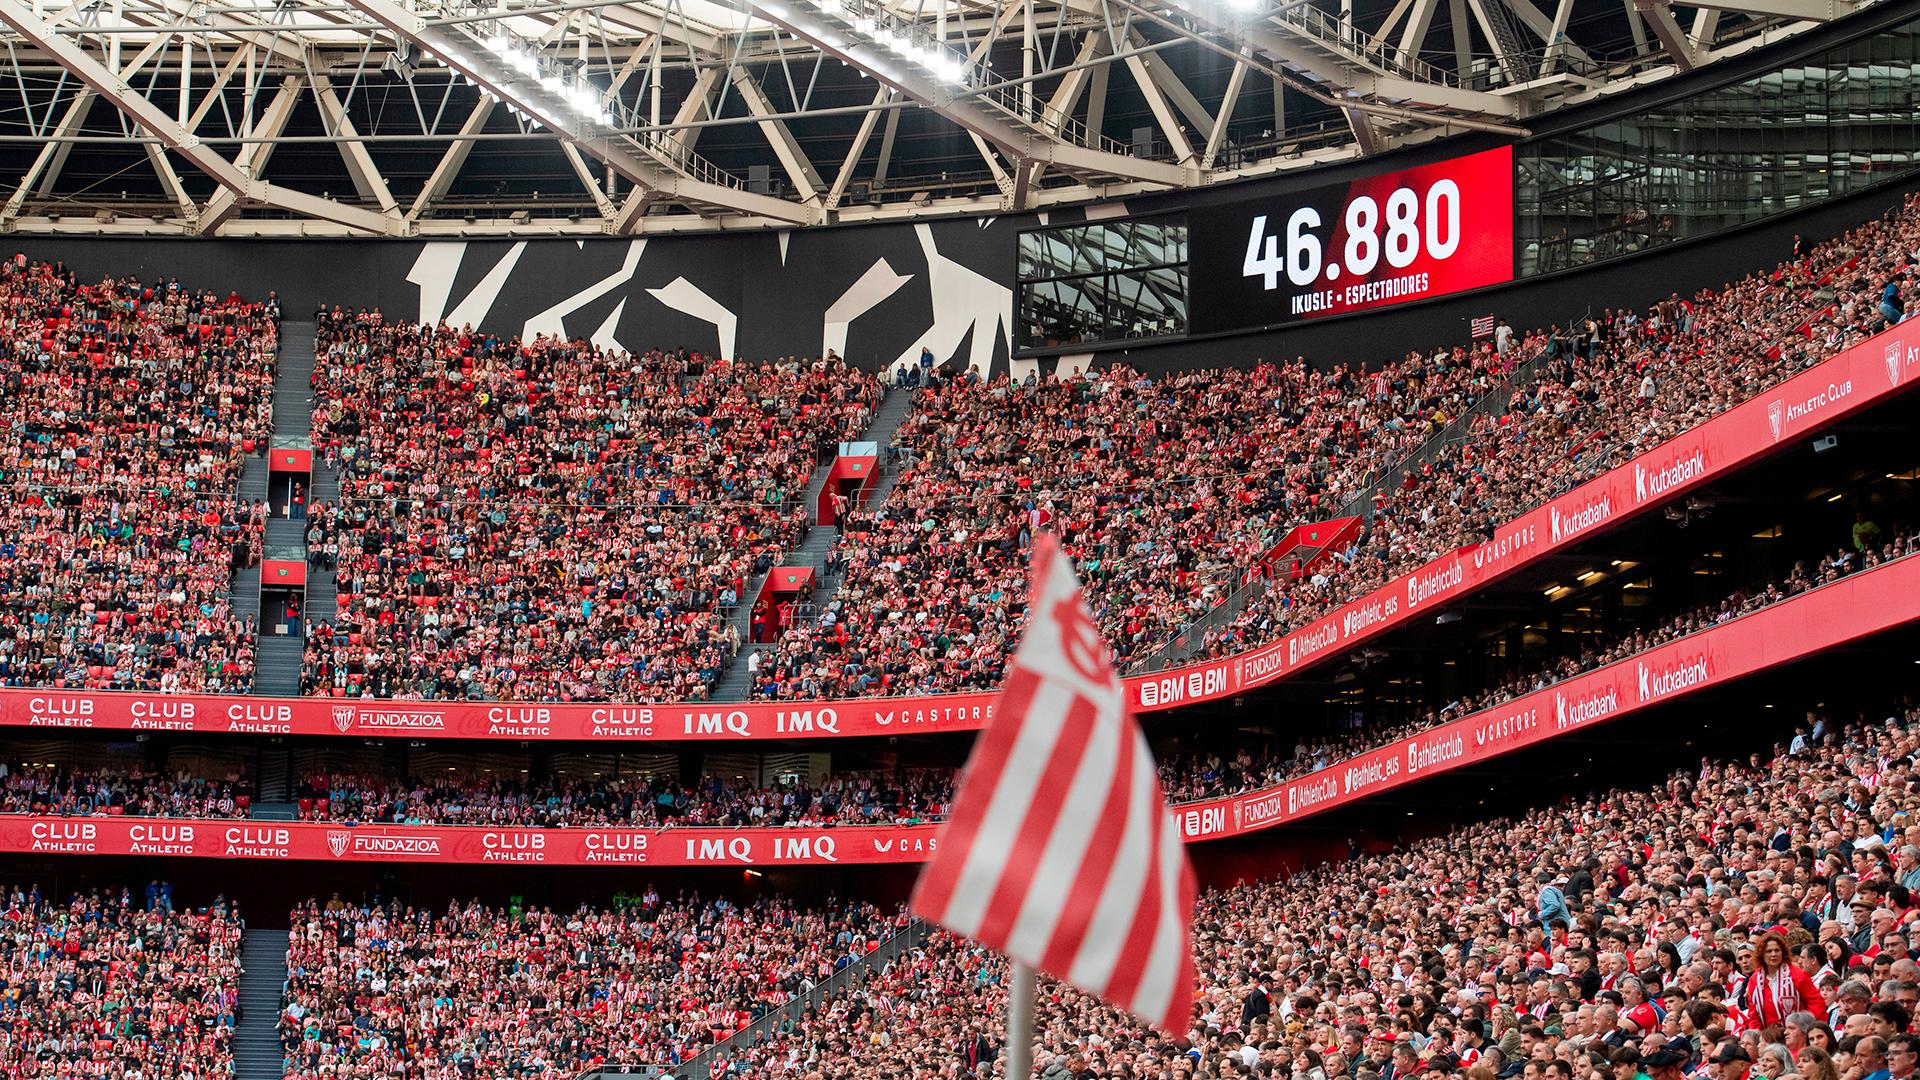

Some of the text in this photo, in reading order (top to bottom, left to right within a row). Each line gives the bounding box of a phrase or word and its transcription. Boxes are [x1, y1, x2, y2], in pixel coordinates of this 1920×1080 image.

[1243, 179, 1460, 291] 46.880
[1292, 273, 1428, 314] IKUSLE ESPECTADORES
[1787, 381, 1852, 422] ATHLETIC CLUB
[1650, 453, 1704, 496] kutxabank
[1564, 496, 1610, 537] kutxabank
[1487, 531, 1535, 562] CASTORE
[1417, 559, 1462, 602] athleticclub
[1351, 599, 1397, 634] @athletic_eus
[1246, 655, 1281, 678] FUNDAZIOA
[1205, 666, 1227, 694] BM
[1653, 658, 1708, 698] kutxabank
[1160, 676, 1184, 703] BM
[30, 698, 94, 714] CLUB
[131, 701, 195, 717] CLUB
[228, 705, 291, 720] CLUB
[902, 706, 992, 724] CASTORE
[1569, 690, 1617, 725] kutxabank
[30, 715, 93, 727] ATHLETIC
[131, 718, 193, 730] ATHLETIC
[360, 713, 444, 726] FUNDAZIOA
[489, 708, 550, 724] CLUB
[592, 709, 653, 724] CLUB
[685, 712, 752, 736] IMQ
[777, 708, 840, 733] IMQ
[1489, 710, 1536, 740] CASTORE
[229, 720, 290, 733] ATHLETIC
[489, 724, 550, 735] ATHLETIC
[593, 724, 653, 735] ATHLETIC
[1417, 732, 1462, 769] athleticclub
[1352, 756, 1399, 791] @athletic_eus
[1202, 808, 1224, 834] BM
[1245, 801, 1281, 823] FUNDAZIOA
[32, 823, 96, 839] CLUB
[130, 825, 194, 841] CLUB
[226, 828, 289, 844] CLUB
[32, 840, 95, 851] ATHLETIC
[130, 841, 192, 854] ATHLETIC
[355, 839, 440, 852] FUNDAZIOA
[483, 833, 545, 849] CLUB
[586, 834, 646, 849] CLUB
[687, 838, 754, 862] IMQ
[774, 836, 838, 861] IMQ
[226, 844, 288, 857] ATHLETIC
[484, 850, 544, 861] ATHLETIC
[586, 850, 646, 861] ATHLETIC
